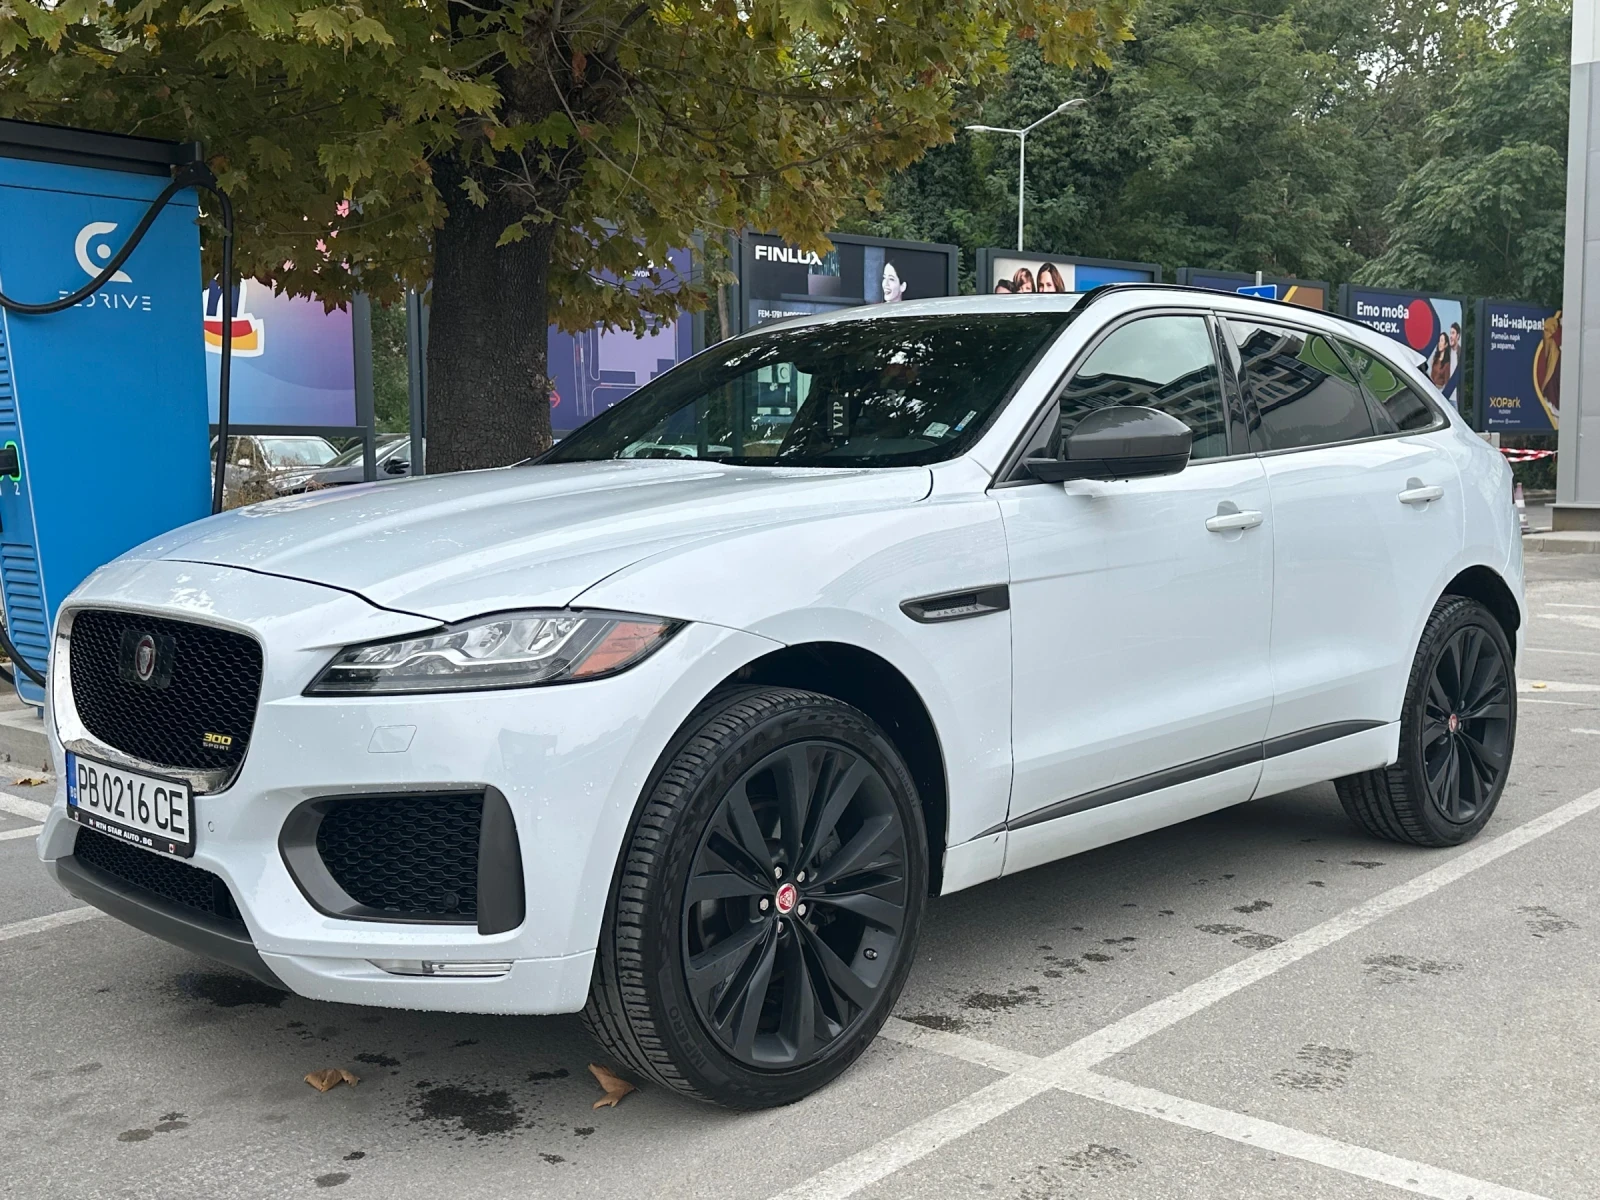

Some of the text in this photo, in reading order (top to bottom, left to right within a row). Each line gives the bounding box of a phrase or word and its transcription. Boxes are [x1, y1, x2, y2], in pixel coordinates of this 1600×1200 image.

[755, 245, 823, 266] FINLUX
[1356, 301, 1410, 320] Ето това
[1360, 320, 1400, 333] рсех.
[1491, 313, 1545, 333] Най-накрая!
[833, 401, 844, 430] VIP
[13, 482, 20, 495] 2
[936, 605, 979, 616] JAGUAR
[203, 732, 232, 745] 300
[203, 741, 228, 750] SPORT
[107, 825, 122, 837] STAR
[669, 1005, 708, 1069] IMPERO
